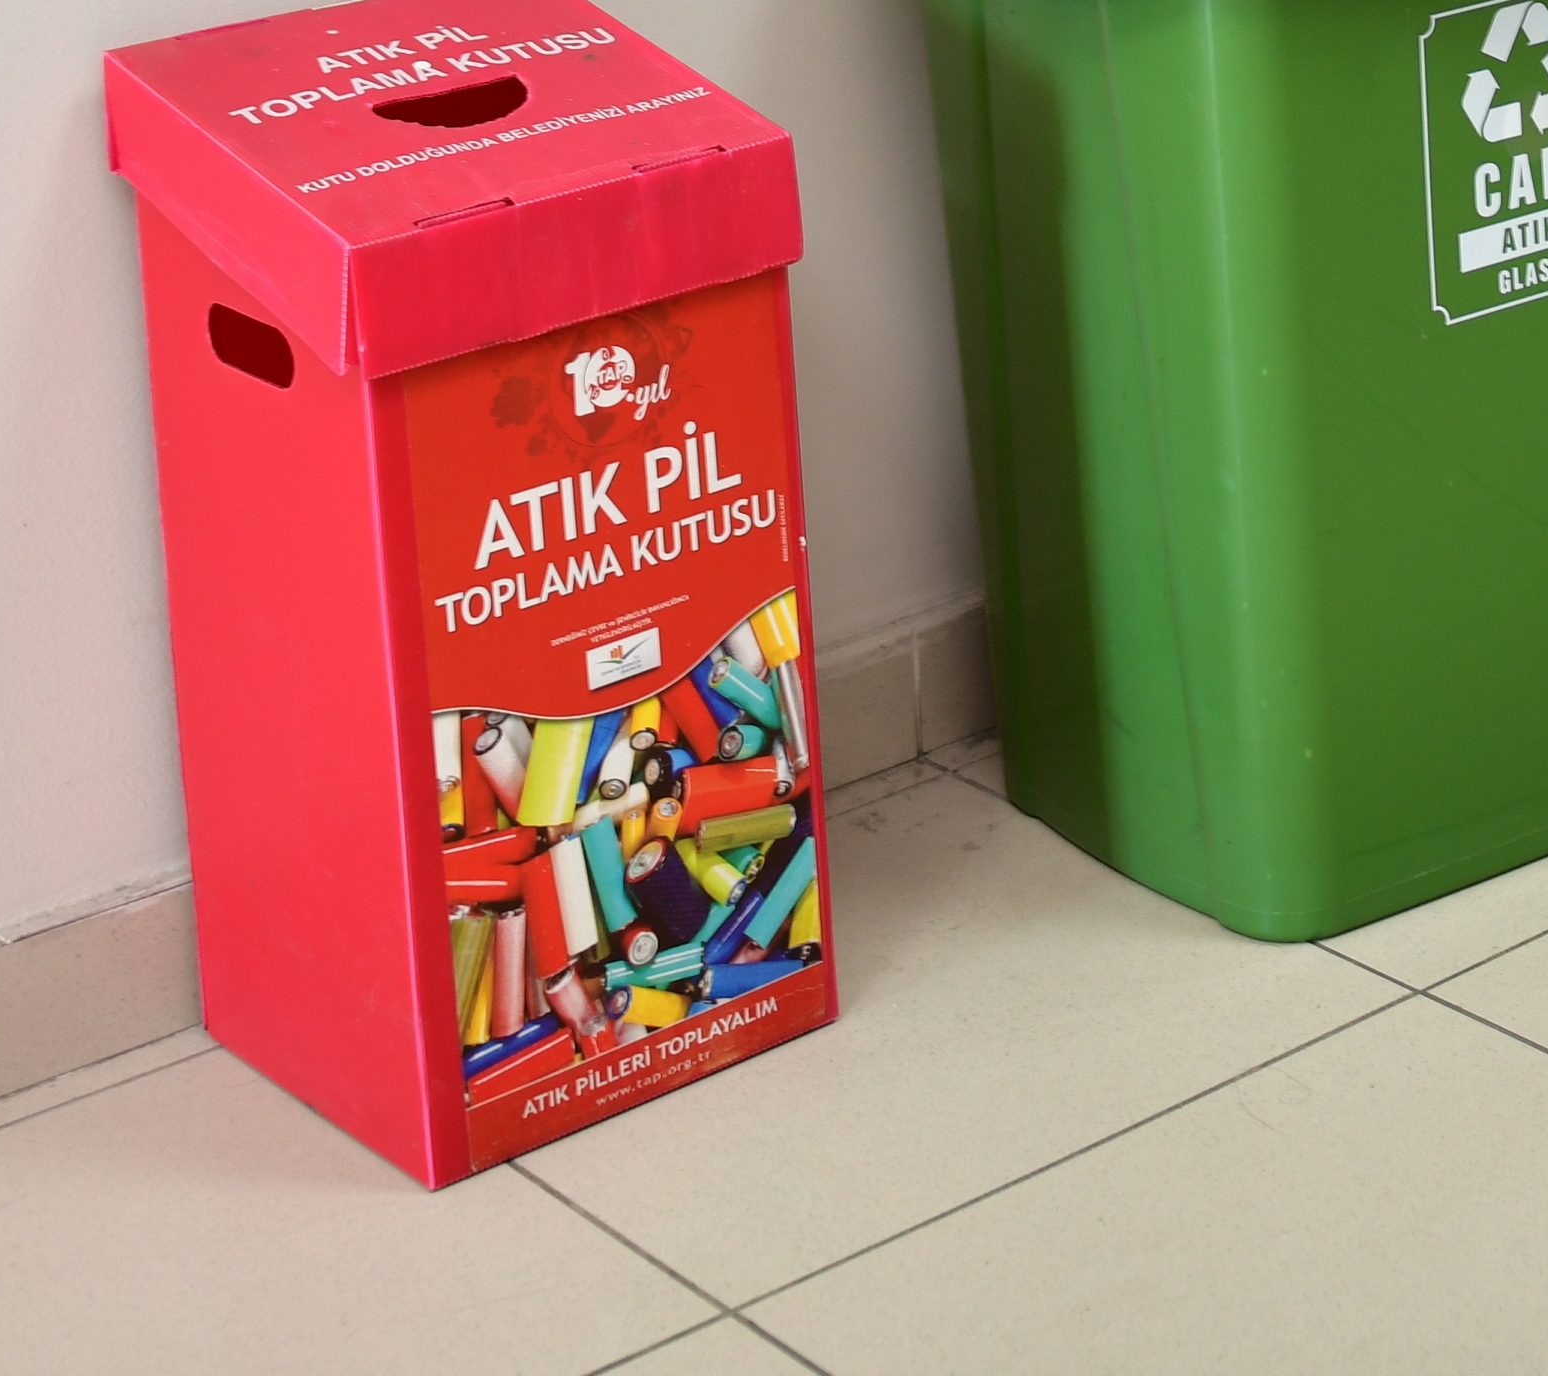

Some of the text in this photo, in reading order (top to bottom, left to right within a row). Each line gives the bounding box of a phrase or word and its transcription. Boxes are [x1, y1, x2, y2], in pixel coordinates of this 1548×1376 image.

[229, 27, 616, 126] TOPLAMA KUTUSU
[317, 23, 490, 75] ATIK PİL
[297, 85, 712, 195] KUTU DOLDUĞUNDA BELEDİYENİZİ ARAYINIZ
[598, 360, 628, 384] TAP
[474, 421, 741, 570] ATIK PİL
[435, 544, 623, 632] TOPLAMA
[631, 490, 776, 570] KUTUSU
[522, 996, 778, 1119] ATIK PİLLERİ TOPLAYALIM
[595, 1049, 712, 1106] www.tap.org.tr
